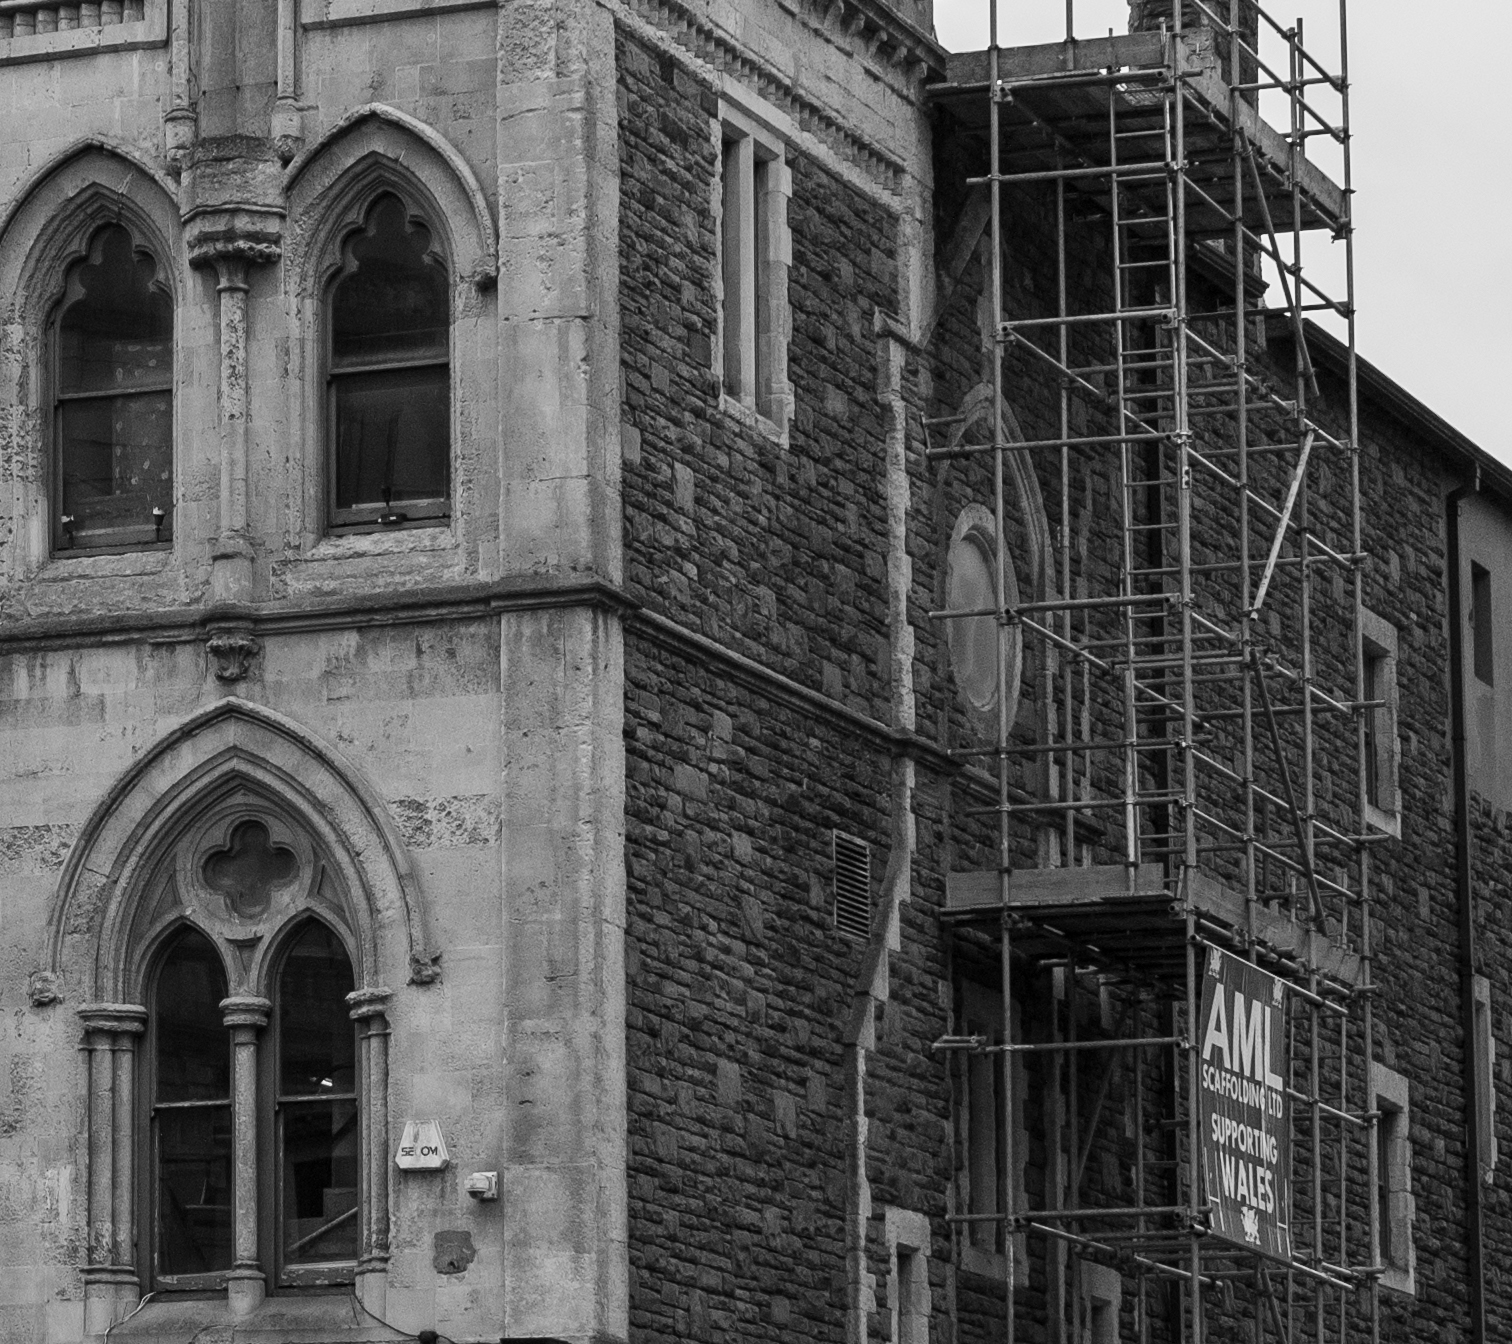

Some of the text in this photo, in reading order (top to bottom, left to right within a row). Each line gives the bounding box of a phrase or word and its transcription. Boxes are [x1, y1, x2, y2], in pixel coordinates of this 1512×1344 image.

[1203, 982, 1283, 1091] AML
[1203, 1064, 1282, 1119] SCAFFOLDING LTD
[1211, 1113, 1277, 1164] SUPPORTING
[1220, 1151, 1273, 1214] WALES
